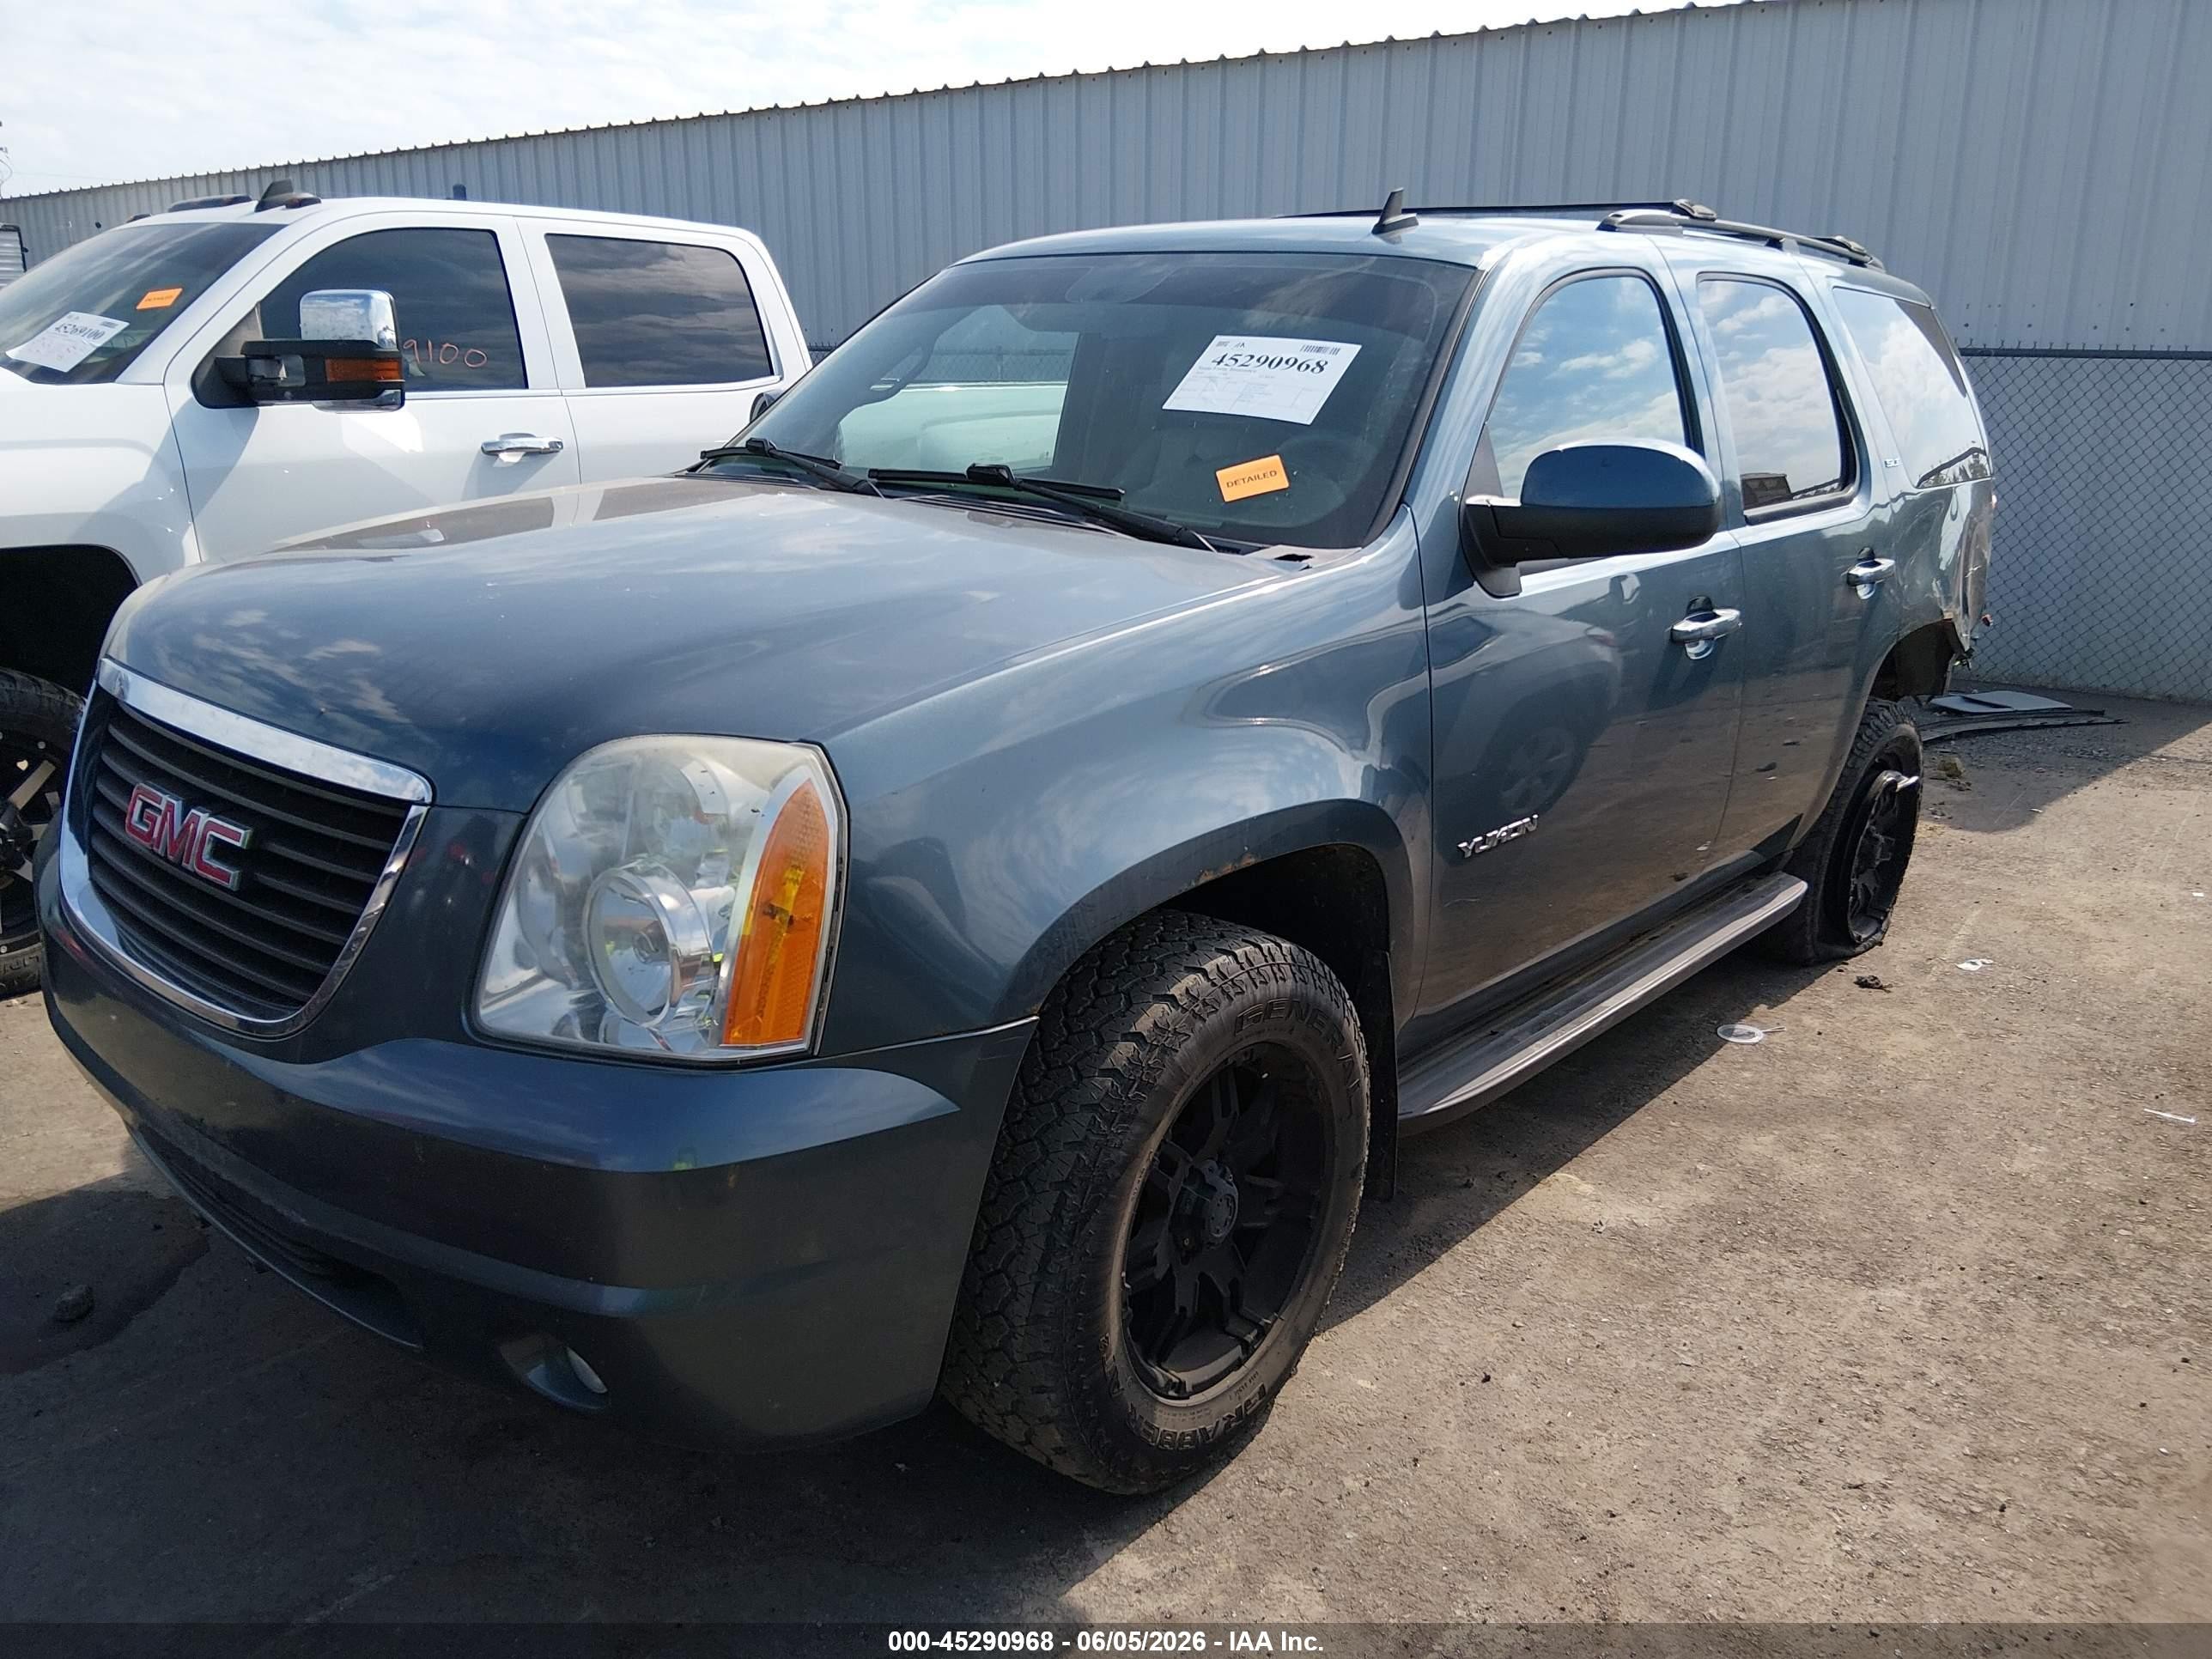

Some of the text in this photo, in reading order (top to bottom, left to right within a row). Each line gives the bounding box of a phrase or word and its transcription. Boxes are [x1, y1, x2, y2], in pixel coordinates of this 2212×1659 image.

[403, 338, 488, 368] 9100
[1211, 352, 1328, 374] 45290968
[1225, 470, 1278, 489] DETAILED
[125, 781, 253, 891] GMC
[1457, 814, 1539, 859] YUKON
